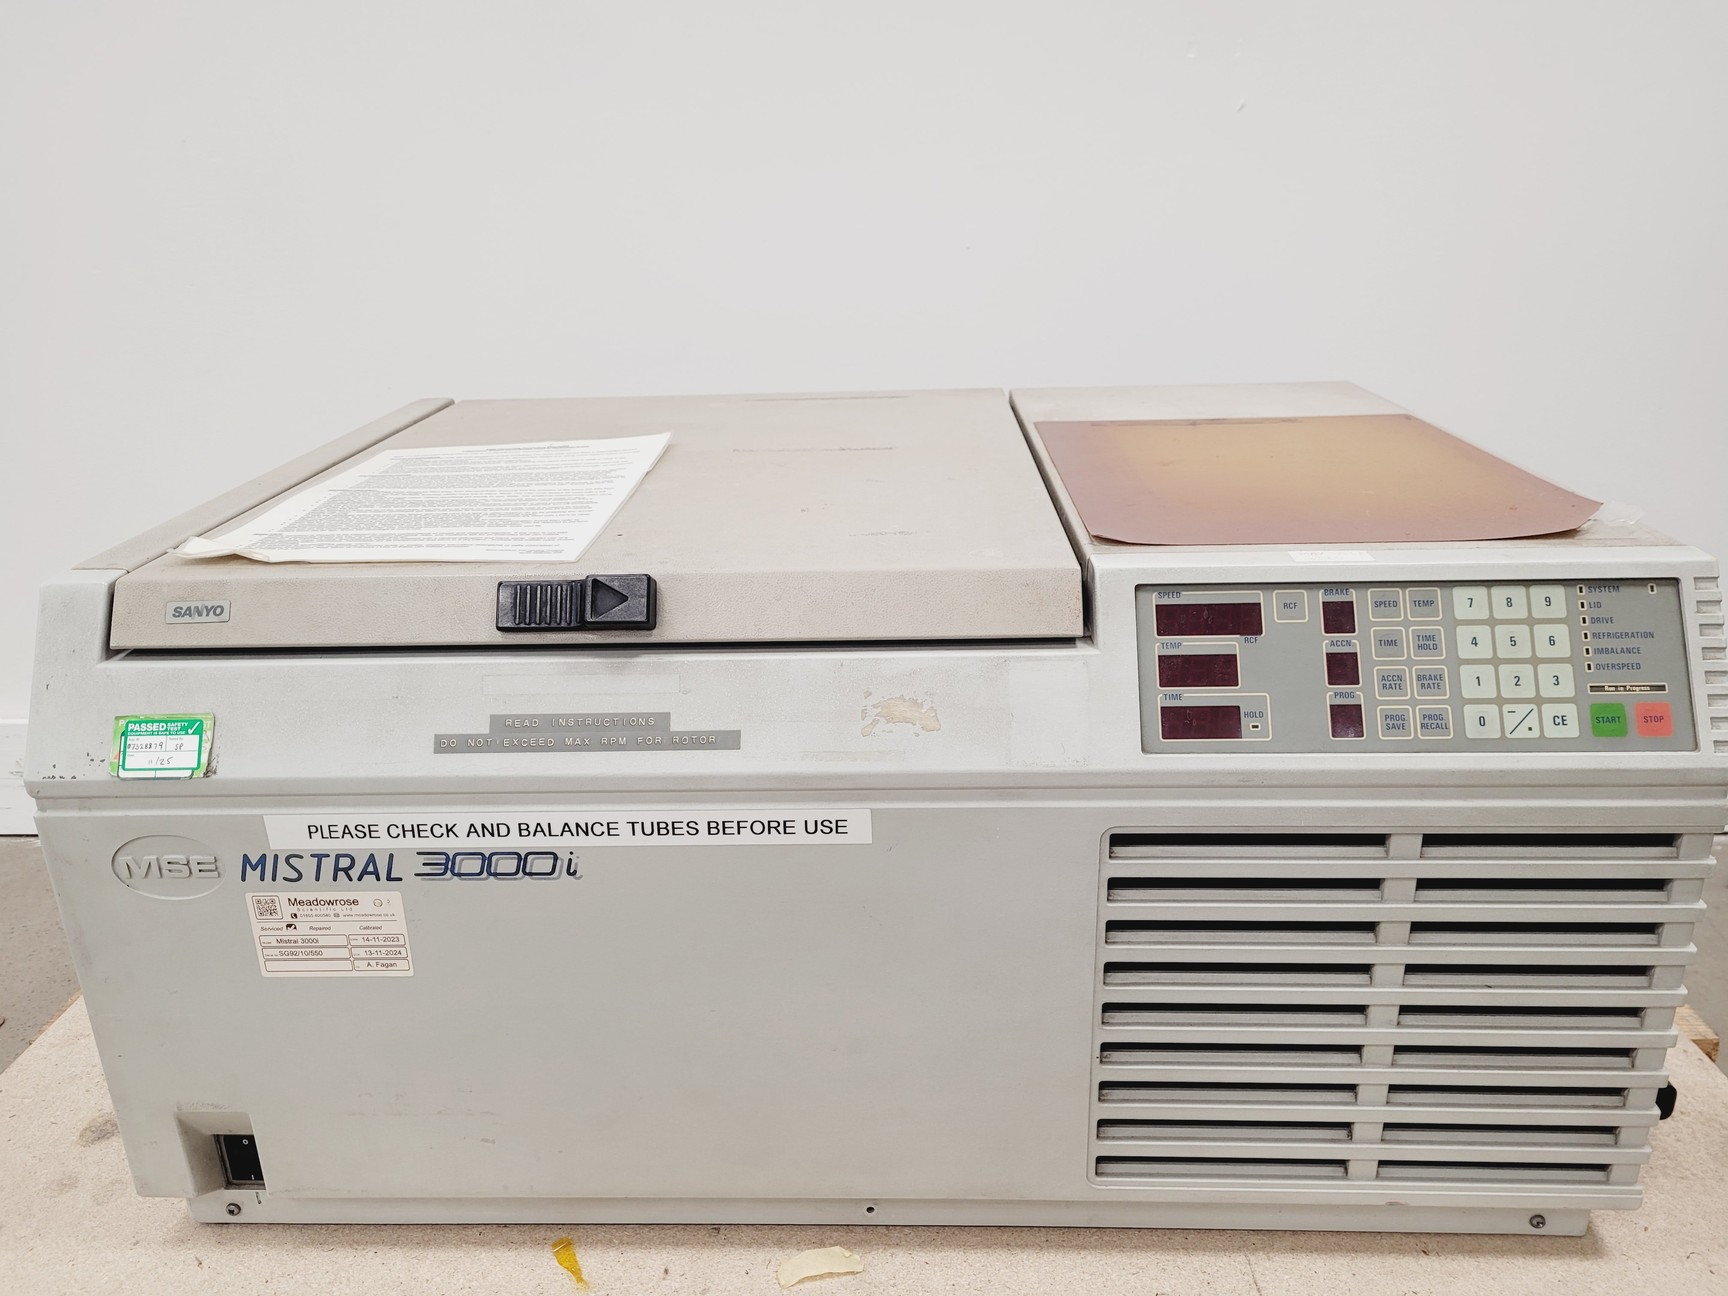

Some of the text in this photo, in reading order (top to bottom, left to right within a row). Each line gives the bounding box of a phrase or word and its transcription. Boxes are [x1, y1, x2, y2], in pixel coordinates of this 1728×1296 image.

[1323, 588, 1350, 597] BRAKE
[1587, 585, 1621, 594] SYSTEM
[1157, 591, 1181, 600] SPEED
[1283, 602, 1298, 610] RCF
[1373, 600, 1398, 609] SPEED
[1412, 599, 1435, 608] TEMP
[1467, 598, 1474, 608] 7
[1505, 597, 1513, 608] 8
[1544, 596, 1552, 607] 9
[1588, 601, 1602, 609] LID
[172, 604, 225, 620] SANYO
[1590, 617, 1615, 625] DRIVE
[1243, 636, 1259, 644] RCF
[1416, 634, 1437, 643] TIME
[1592, 631, 1655, 640] REFRIGERATION
[1378, 639, 1399, 648] TIME
[1471, 636, 1479, 647] 4
[1510, 636, 1517, 647] 5
[1548, 635, 1556, 646] 6
[1160, 641, 1182, 650] TEMP
[1417, 642, 1438, 651] HOLD
[1594, 647, 1642, 656] IMBALANCE
[1595, 662, 1642, 671] OVERSPEED
[1416, 673, 1444, 682] BRAKE
[1475, 676, 1482, 687] 1
[1514, 675, 1522, 687] 2
[1553, 675, 1560, 686] 3
[1382, 682, 1403, 691] RATE
[1420, 681, 1442, 690] RATE
[1163, 693, 1183, 702] TIME
[1243, 710, 1264, 719] HOLD
[1384, 714, 1408, 722] PROG.
[1421, 713, 1446, 722] PROG.
[505, 716, 656, 728] READ INSTRUCTIONS
[1478, 715, 1486, 727] 0
[1552, 714, 1568, 726] CE
[1595, 715, 1621, 725] START
[1643, 715, 1665, 724] STOP
[127, 723, 167, 732] PASSED
[1385, 722, 1406, 731] SAVE
[1420, 721, 1450, 730] RECALL
[440, 734, 717, 748] DO NOT EXCEED MAX RPM FOR ROTOR
[307, 818, 849, 841] PLEASE CHECK AND BALANCE TUBES BEFORE USE
[119, 856, 222, 880] MSE
[239, 851, 579, 883] MISTRAL 3000i
[287, 897, 360, 907] Meadowrose
[375, 961, 398, 969] Fagan
